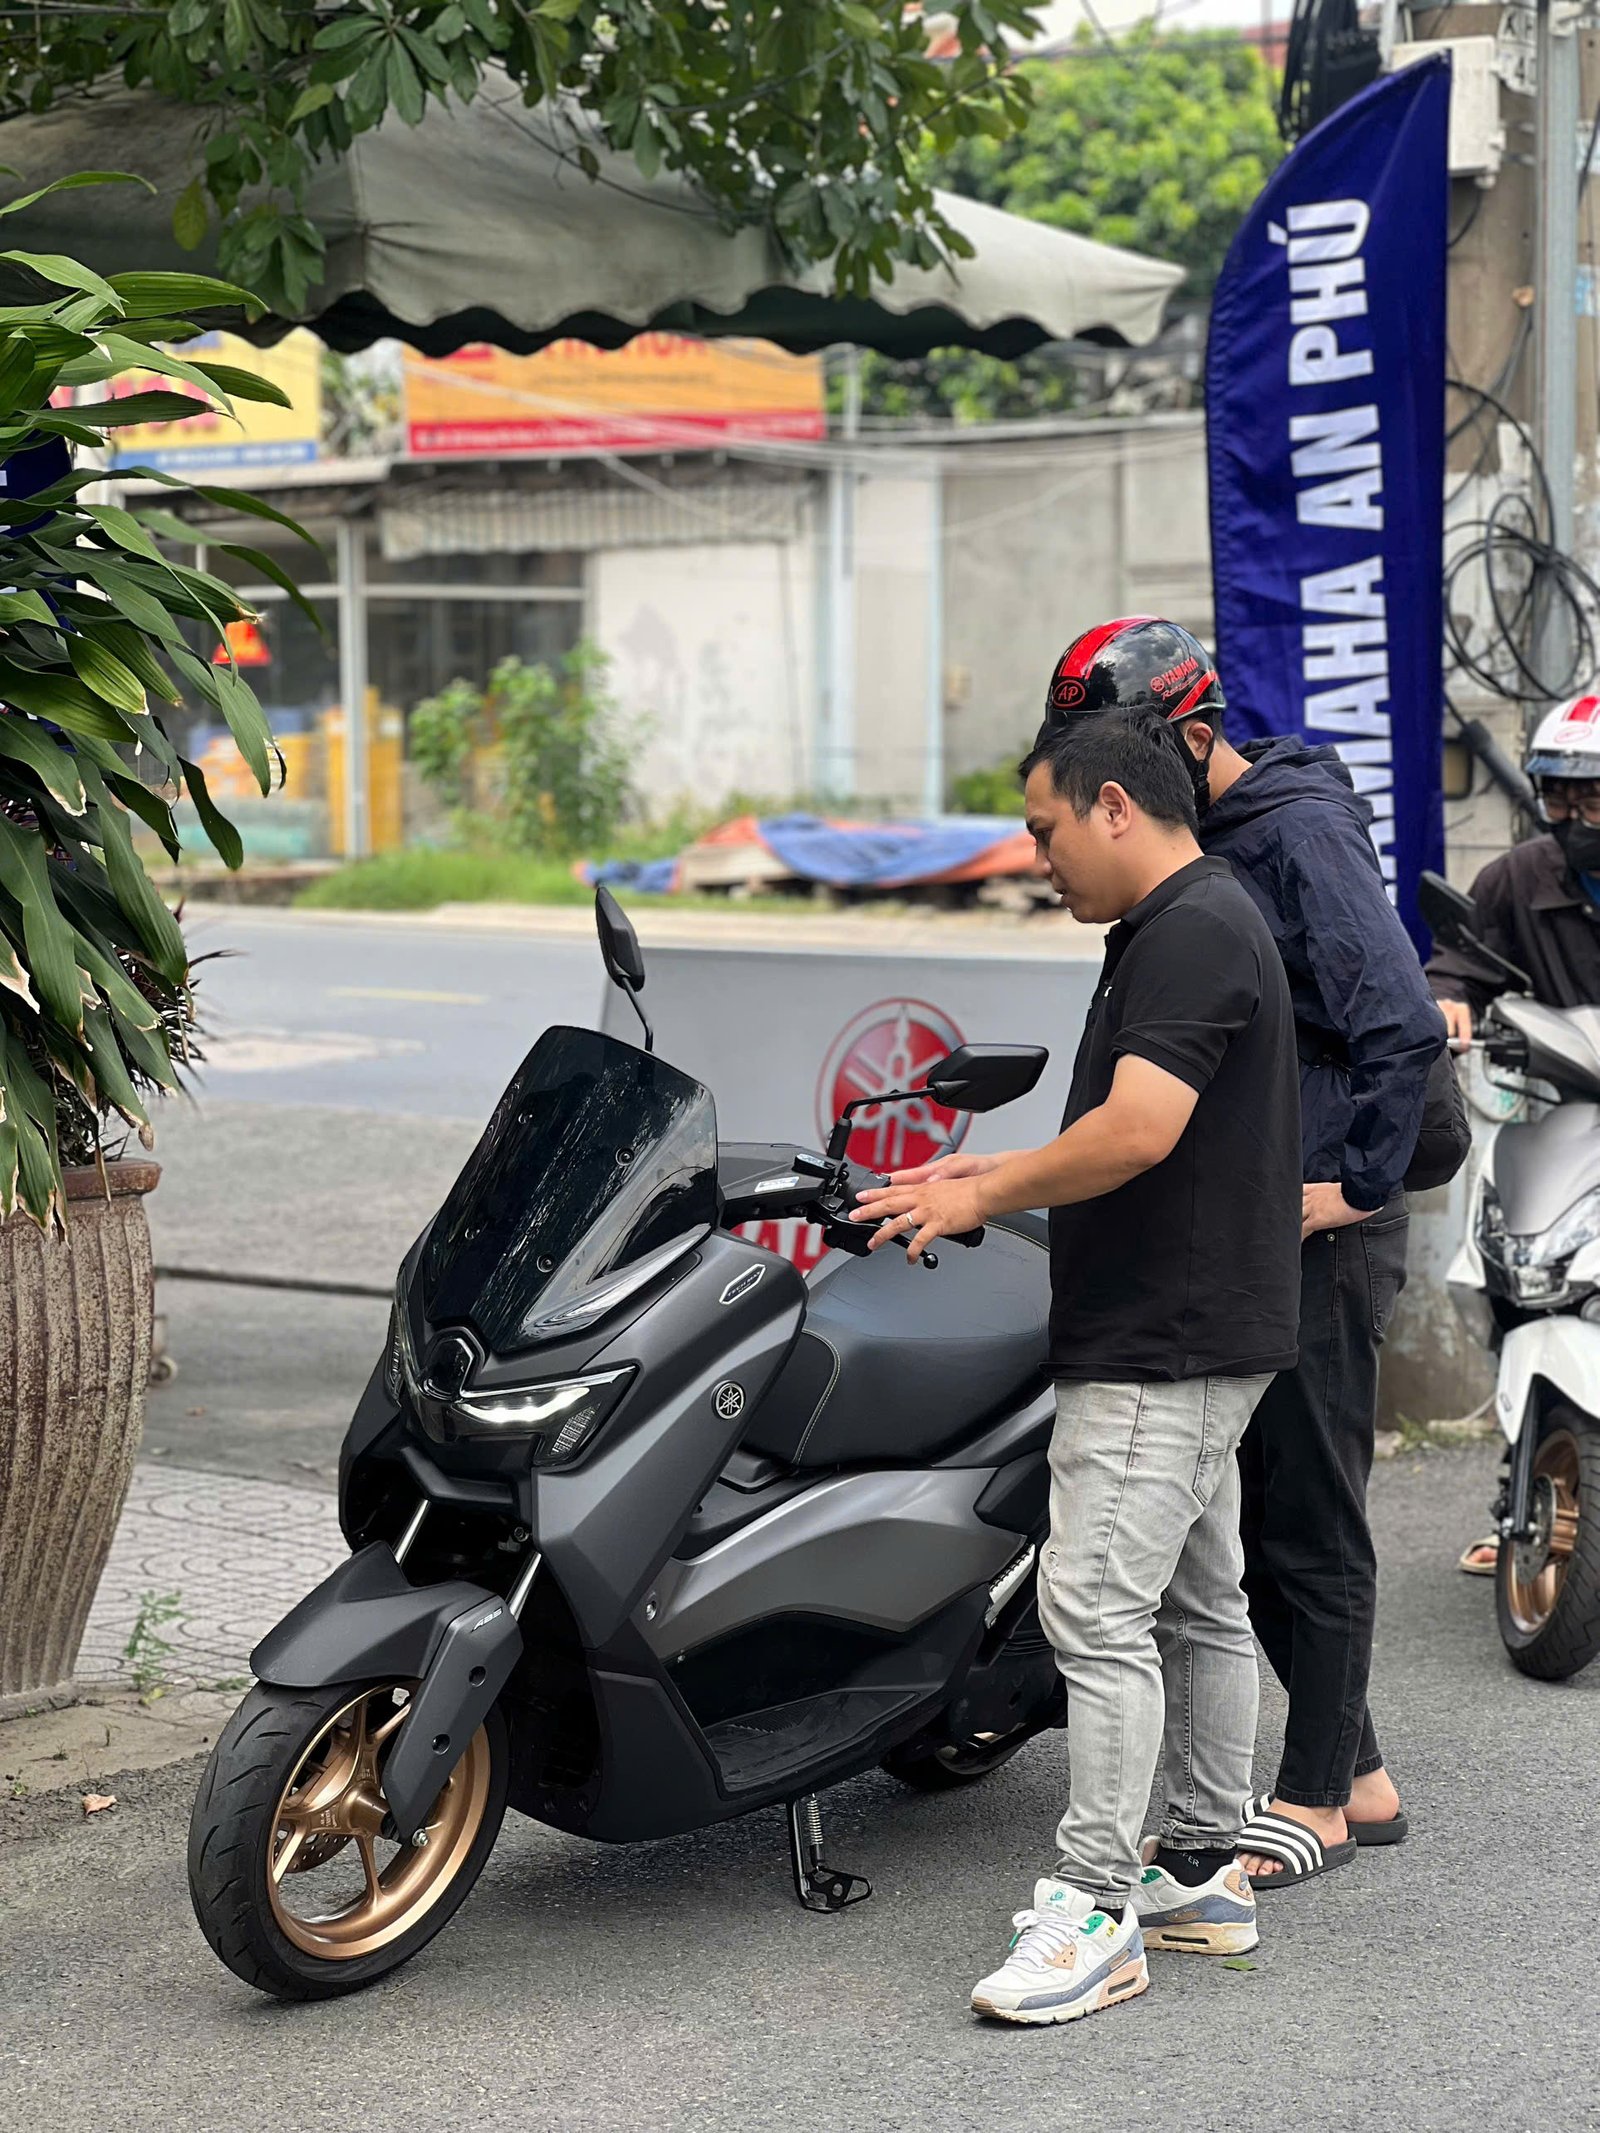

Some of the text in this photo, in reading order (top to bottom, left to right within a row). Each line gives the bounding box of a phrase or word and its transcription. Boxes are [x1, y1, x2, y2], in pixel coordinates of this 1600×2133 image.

[1268, 198, 1374, 386] PHÚ
[1289, 404, 1385, 531] AN
[1161, 656, 1199, 685] YAMAHA
[1058, 685, 1079, 702] AP
[473, 1607, 503, 1631] ABS
